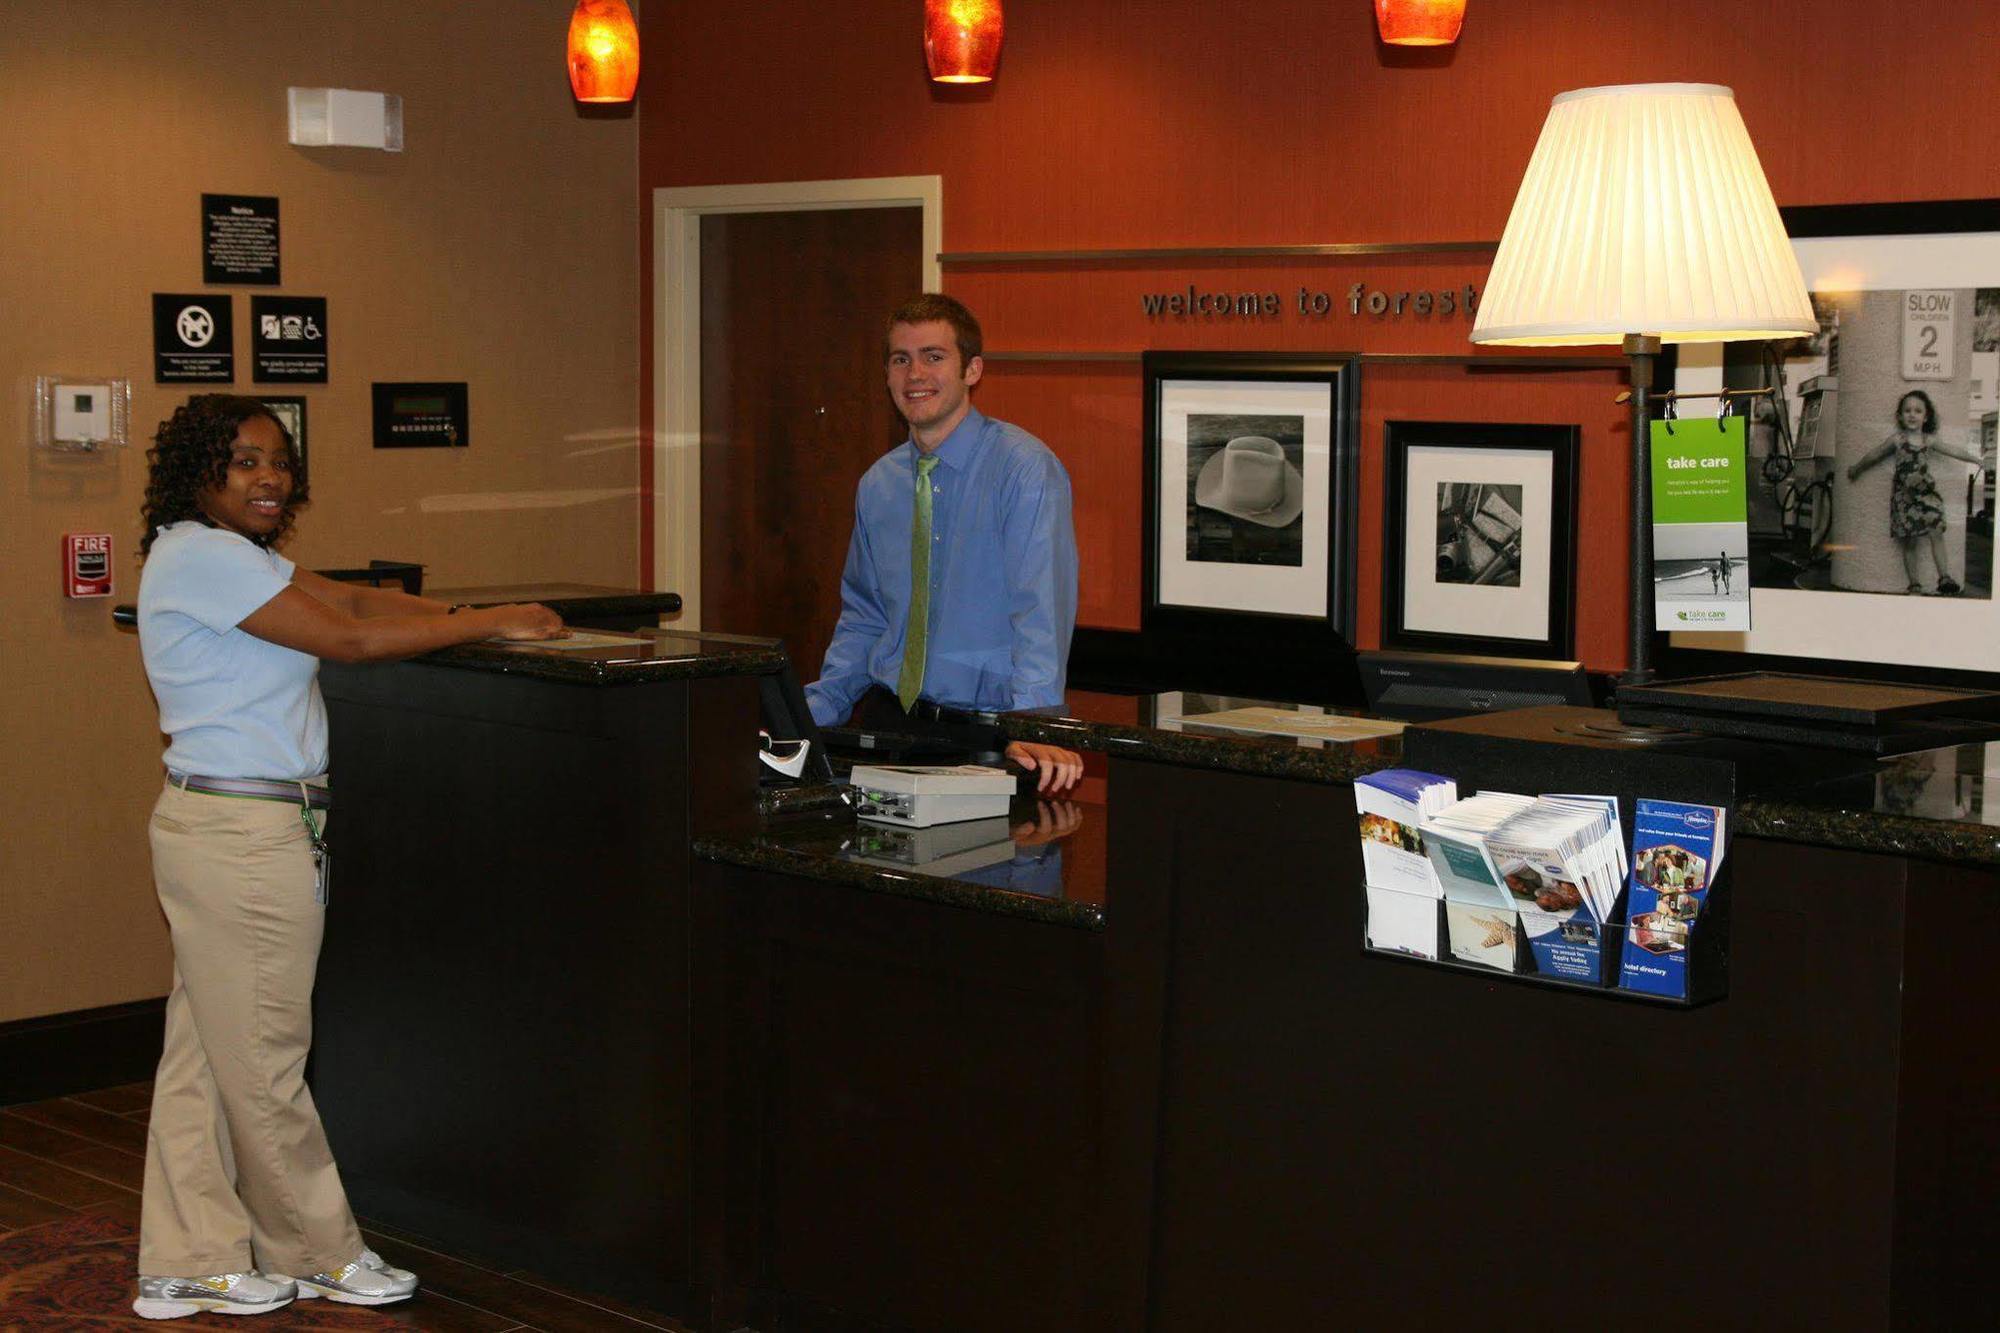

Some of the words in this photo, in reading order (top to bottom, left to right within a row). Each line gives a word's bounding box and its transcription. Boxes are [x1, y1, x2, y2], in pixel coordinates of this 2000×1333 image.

[1142, 285, 1281, 317] welcome
[1298, 288, 1332, 316] to
[1348, 282, 1477, 316] forest
[1908, 293, 1951, 312] SLOW
[1920, 325, 1938, 357] 2
[1666, 456, 1697, 469] take
[1700, 457, 1730, 468] care
[75, 537, 108, 551] FIRE
[1624, 962, 1639, 971] hotel
[1639, 964, 1667, 976] directory
